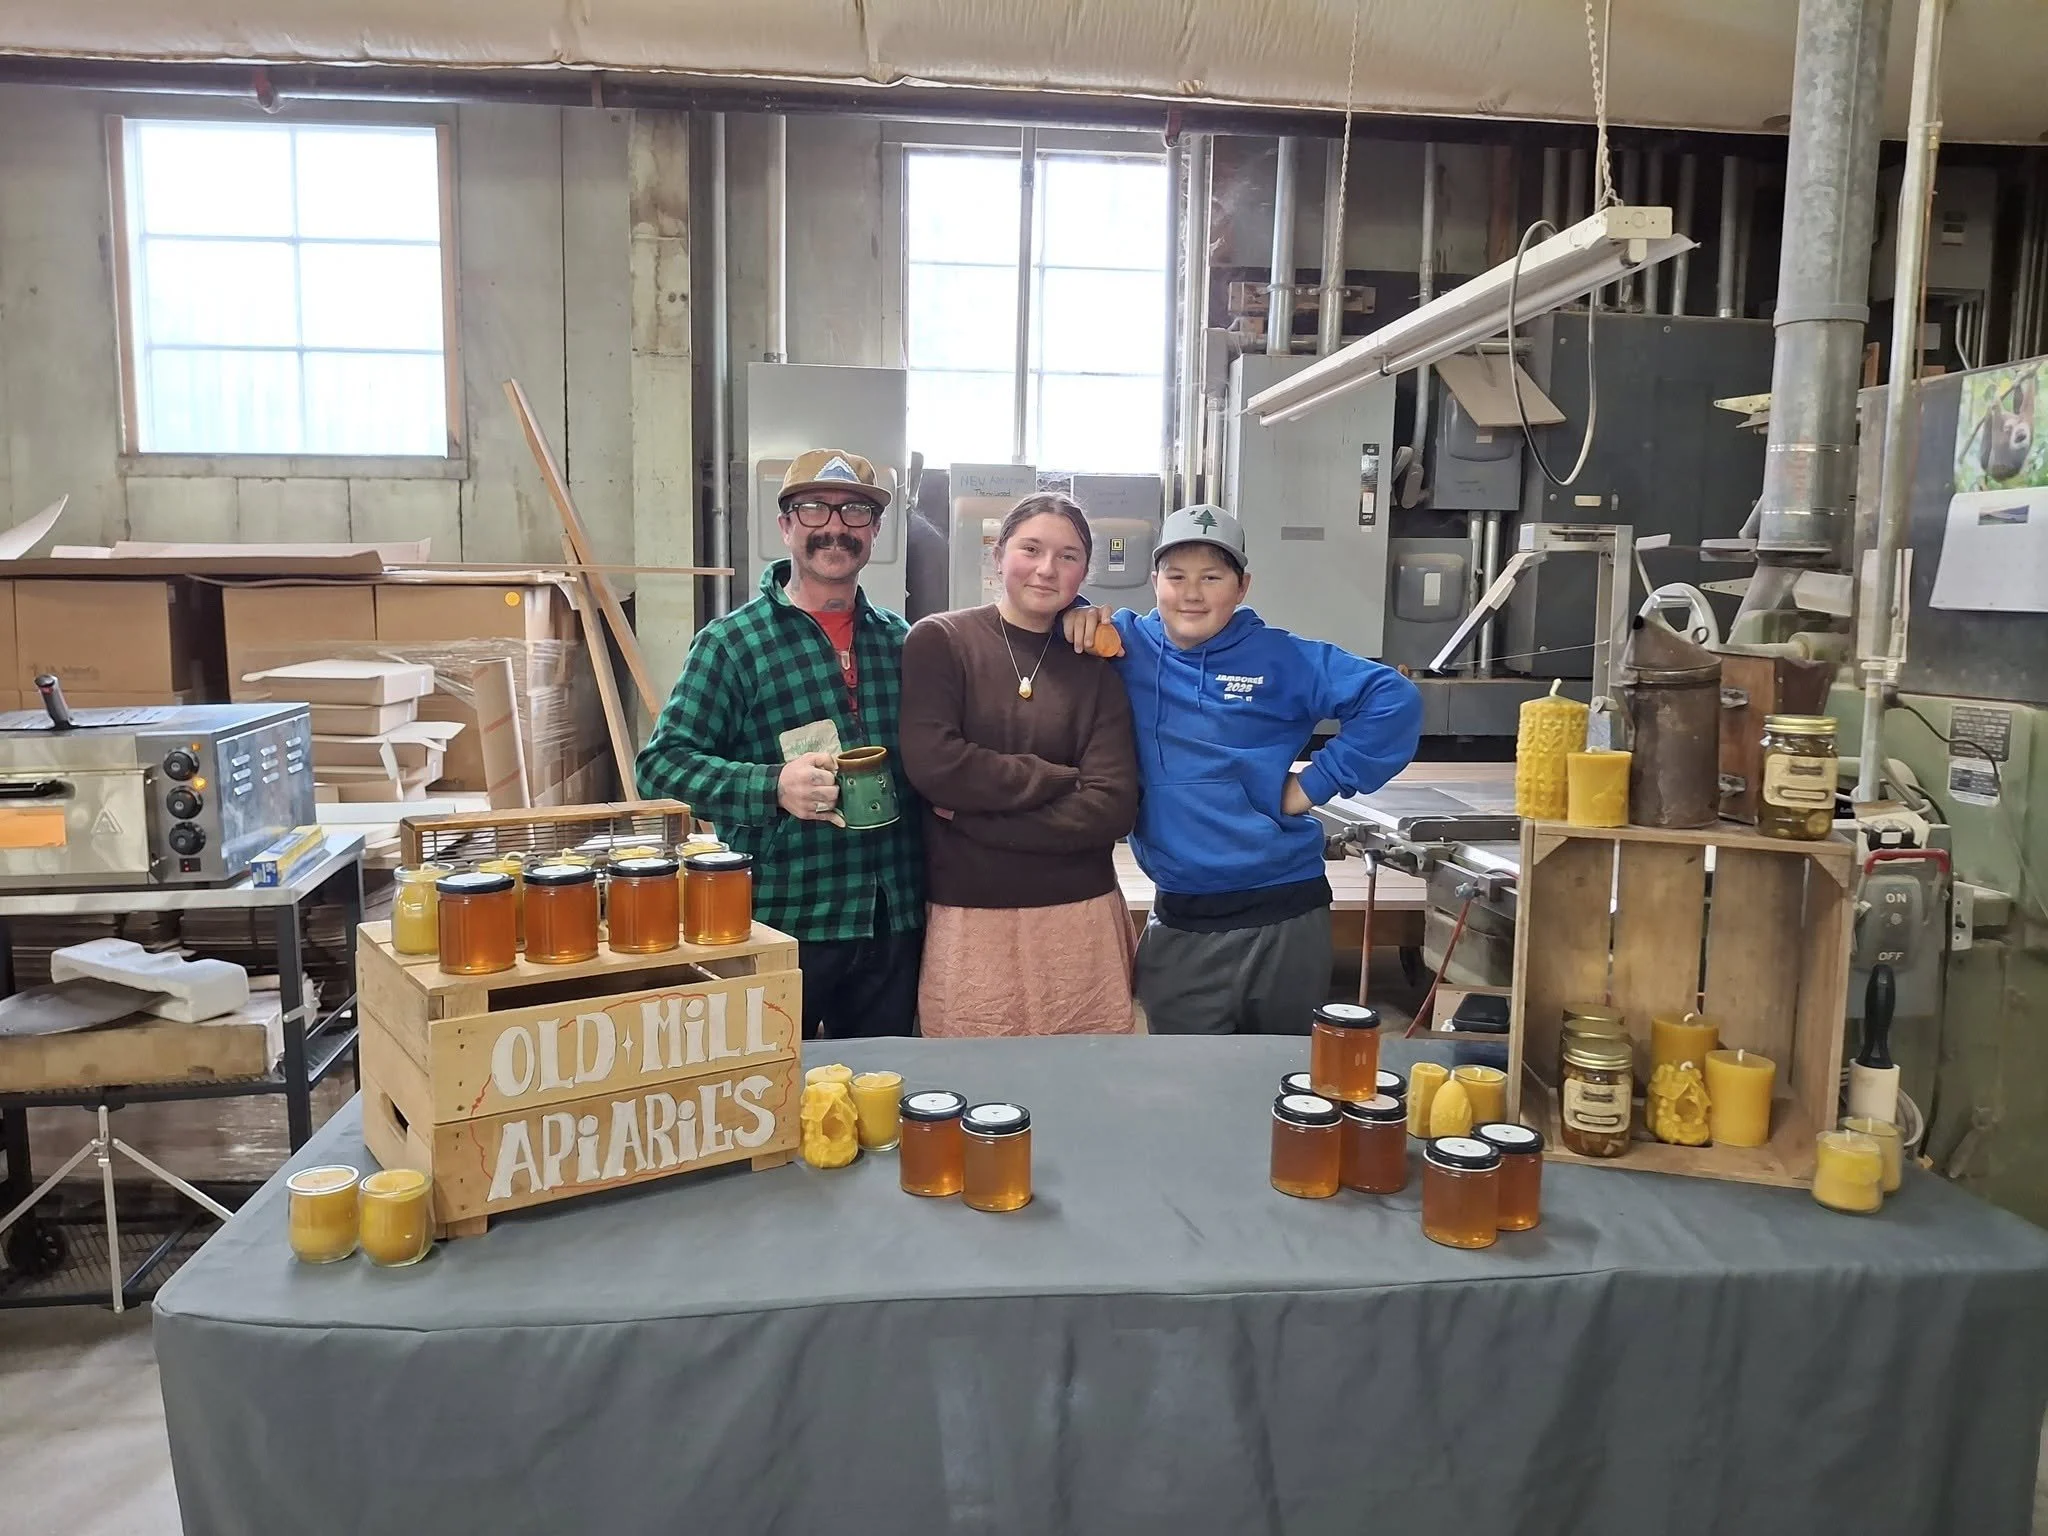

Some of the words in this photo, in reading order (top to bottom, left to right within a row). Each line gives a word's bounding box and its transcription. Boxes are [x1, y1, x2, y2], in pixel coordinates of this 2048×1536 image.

[1224, 682, 1253, 692] 2025
[1885, 893, 1907, 903] ON
[1878, 952, 1904, 960] OFF
[491, 1011, 617, 1097] OLD
